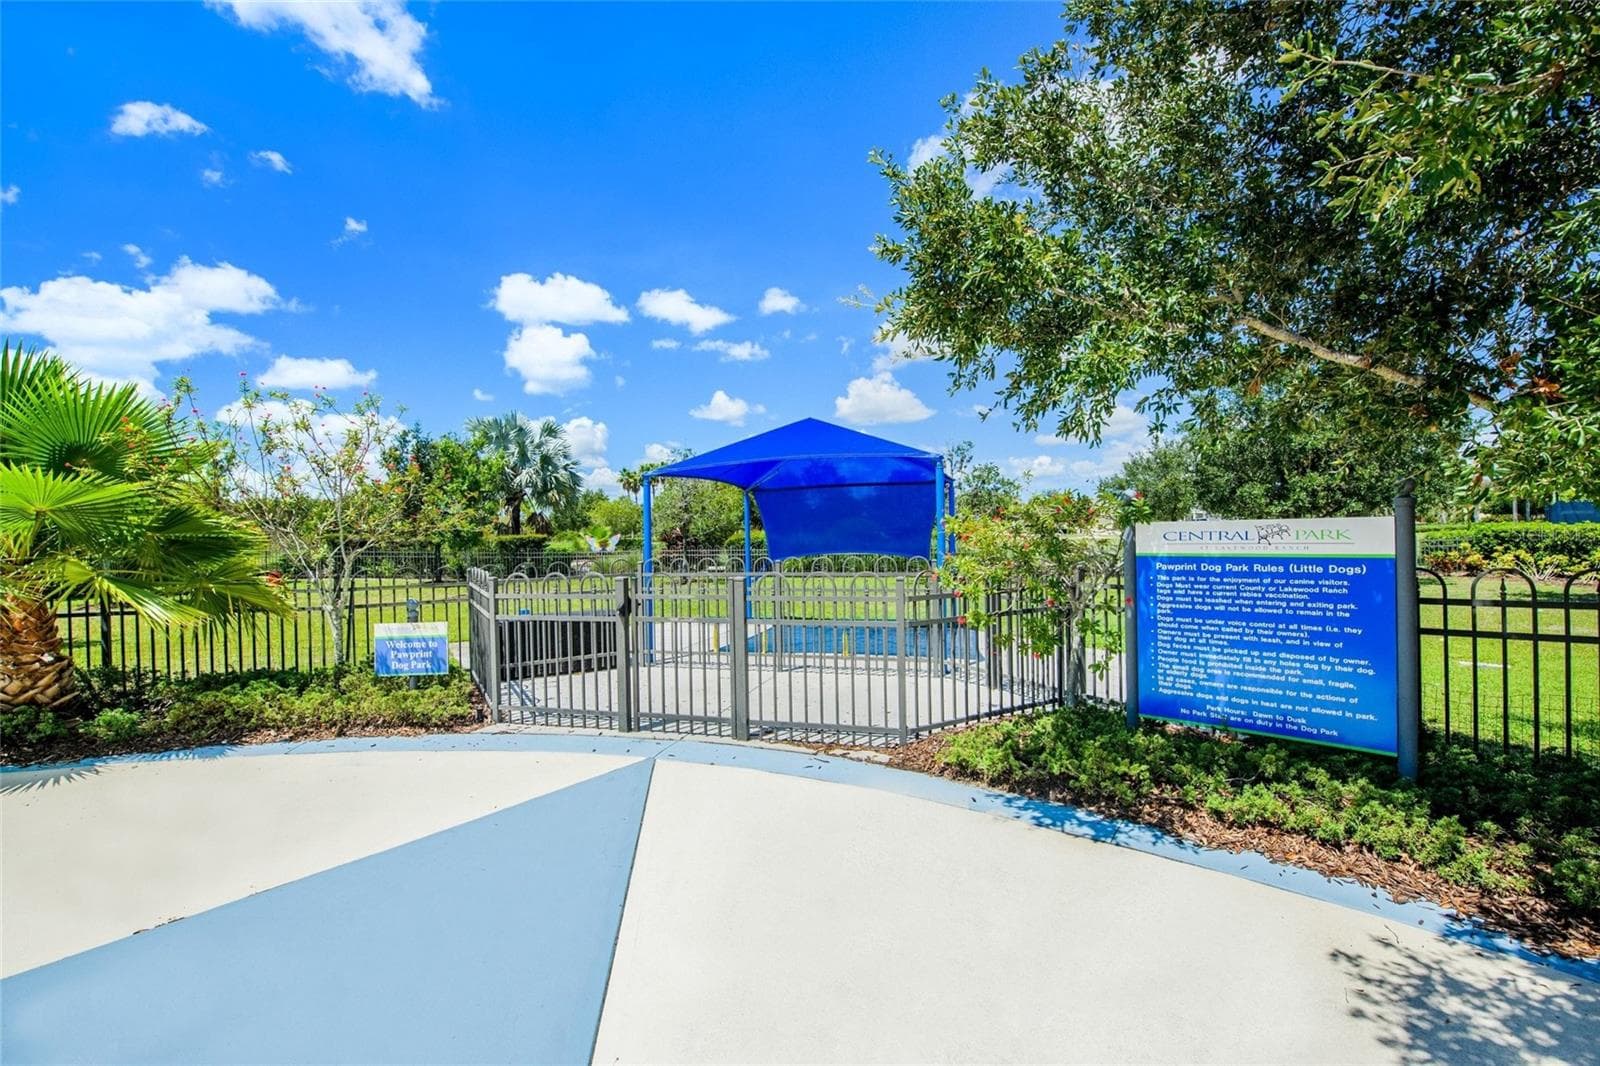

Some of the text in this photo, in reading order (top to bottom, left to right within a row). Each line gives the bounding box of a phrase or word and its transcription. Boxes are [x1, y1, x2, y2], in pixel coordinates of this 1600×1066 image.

[1163, 529, 1351, 541] CENTRAL PARK
[1156, 563, 1196, 571] Pawprint
[1201, 564, 1221, 572] Dog
[1254, 564, 1284, 572] Rules
[1290, 564, 1323, 573] (Little
[1329, 565, 1366, 574] Dogs)
[391, 651, 432, 659] Pawprint
[1279, 652, 1315, 660] disposed
[392, 660, 432, 671] Dog Park
[1159, 688, 1194, 696] Aggressive
[1312, 707, 1342, 716] allowed
[1253, 711, 1273, 719] Dawn
[1287, 716, 1306, 724] Dusk
[1301, 725, 1317, 734] Dog
[1320, 728, 1338, 736] Park
